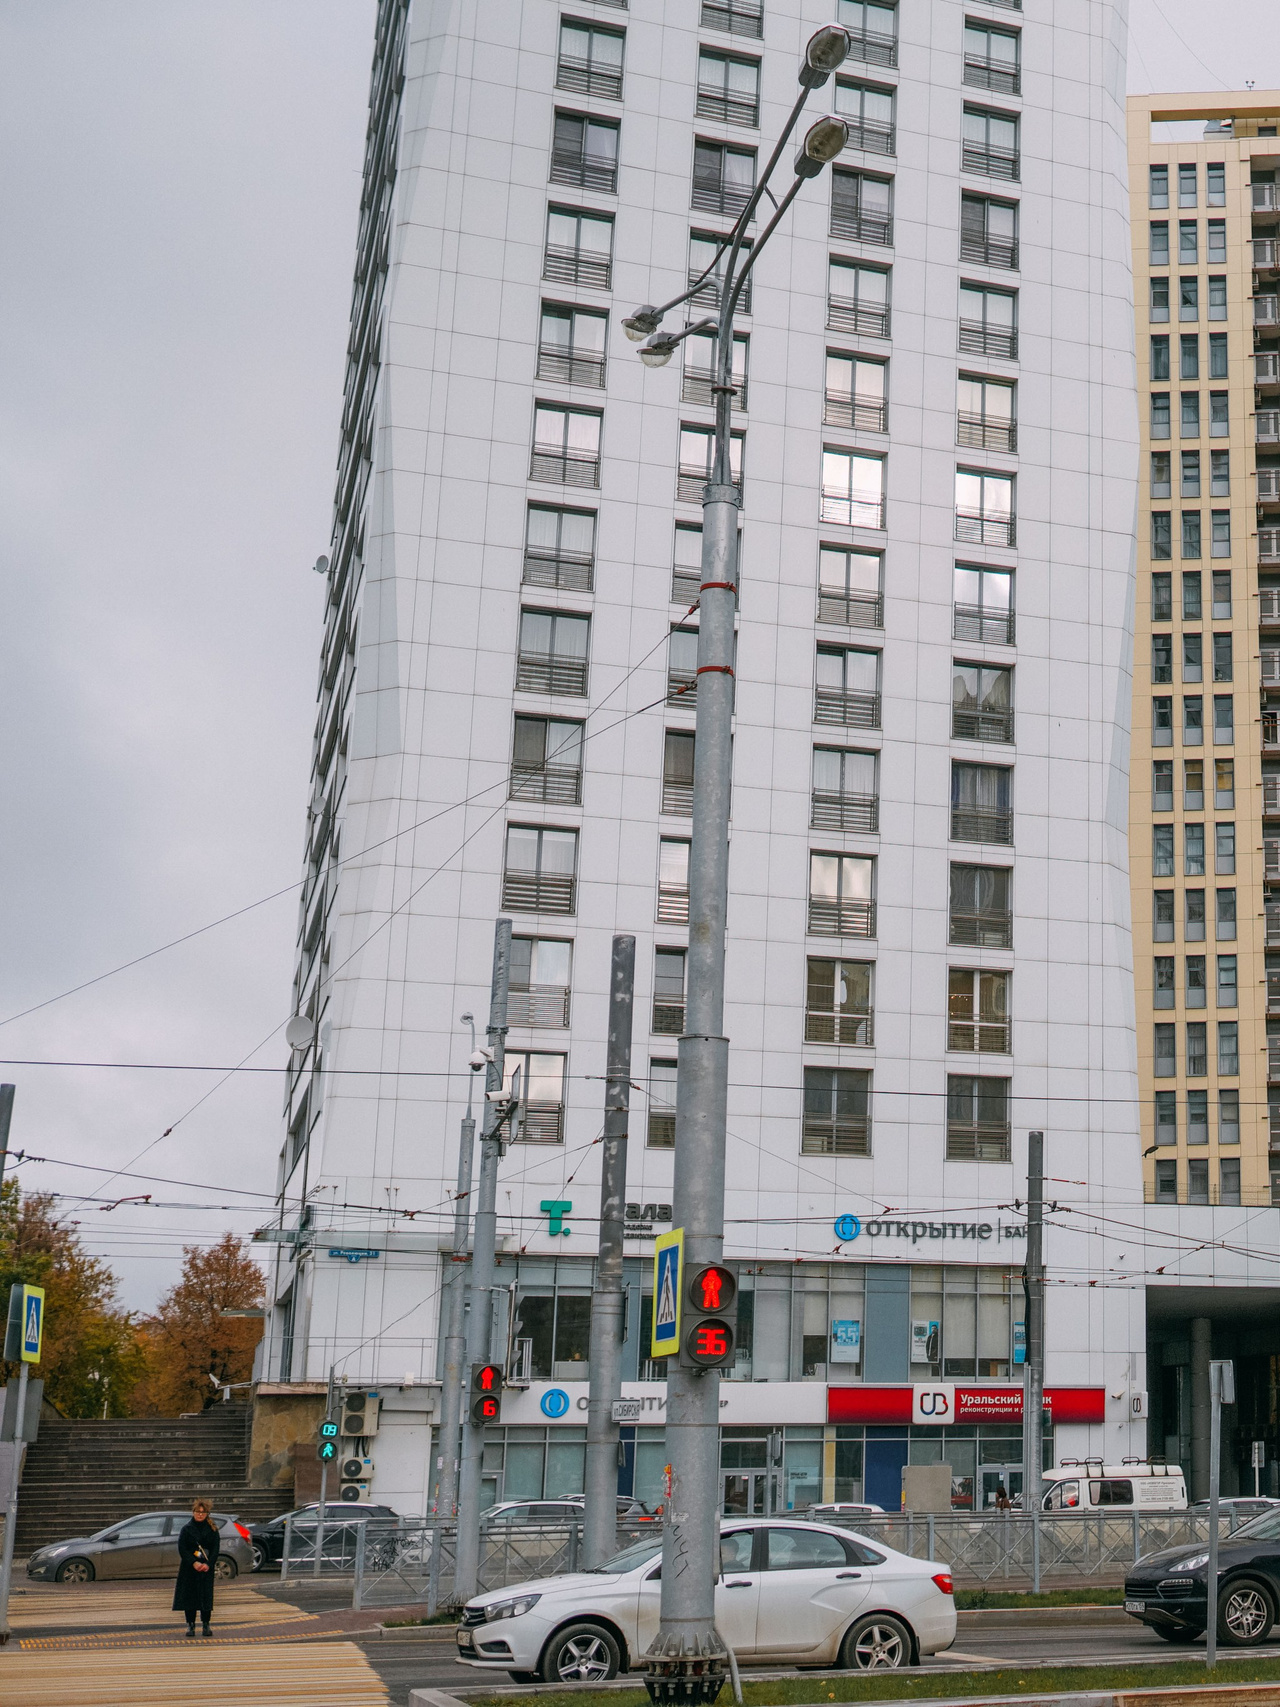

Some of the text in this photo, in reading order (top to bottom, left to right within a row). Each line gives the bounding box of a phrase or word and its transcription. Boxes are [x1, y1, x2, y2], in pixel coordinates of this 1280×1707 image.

[623, 1202, 673, 1220] ала
[866, 1219, 993, 1244] открытие
[697, 1328, 727, 1355] 36
[960, 1394, 1022, 1405] Уральский
[483, 1400, 496, 1416] 16
[960, 1406, 1013, 1414] реконструкции
[322, 1424, 338, 1437] 09
